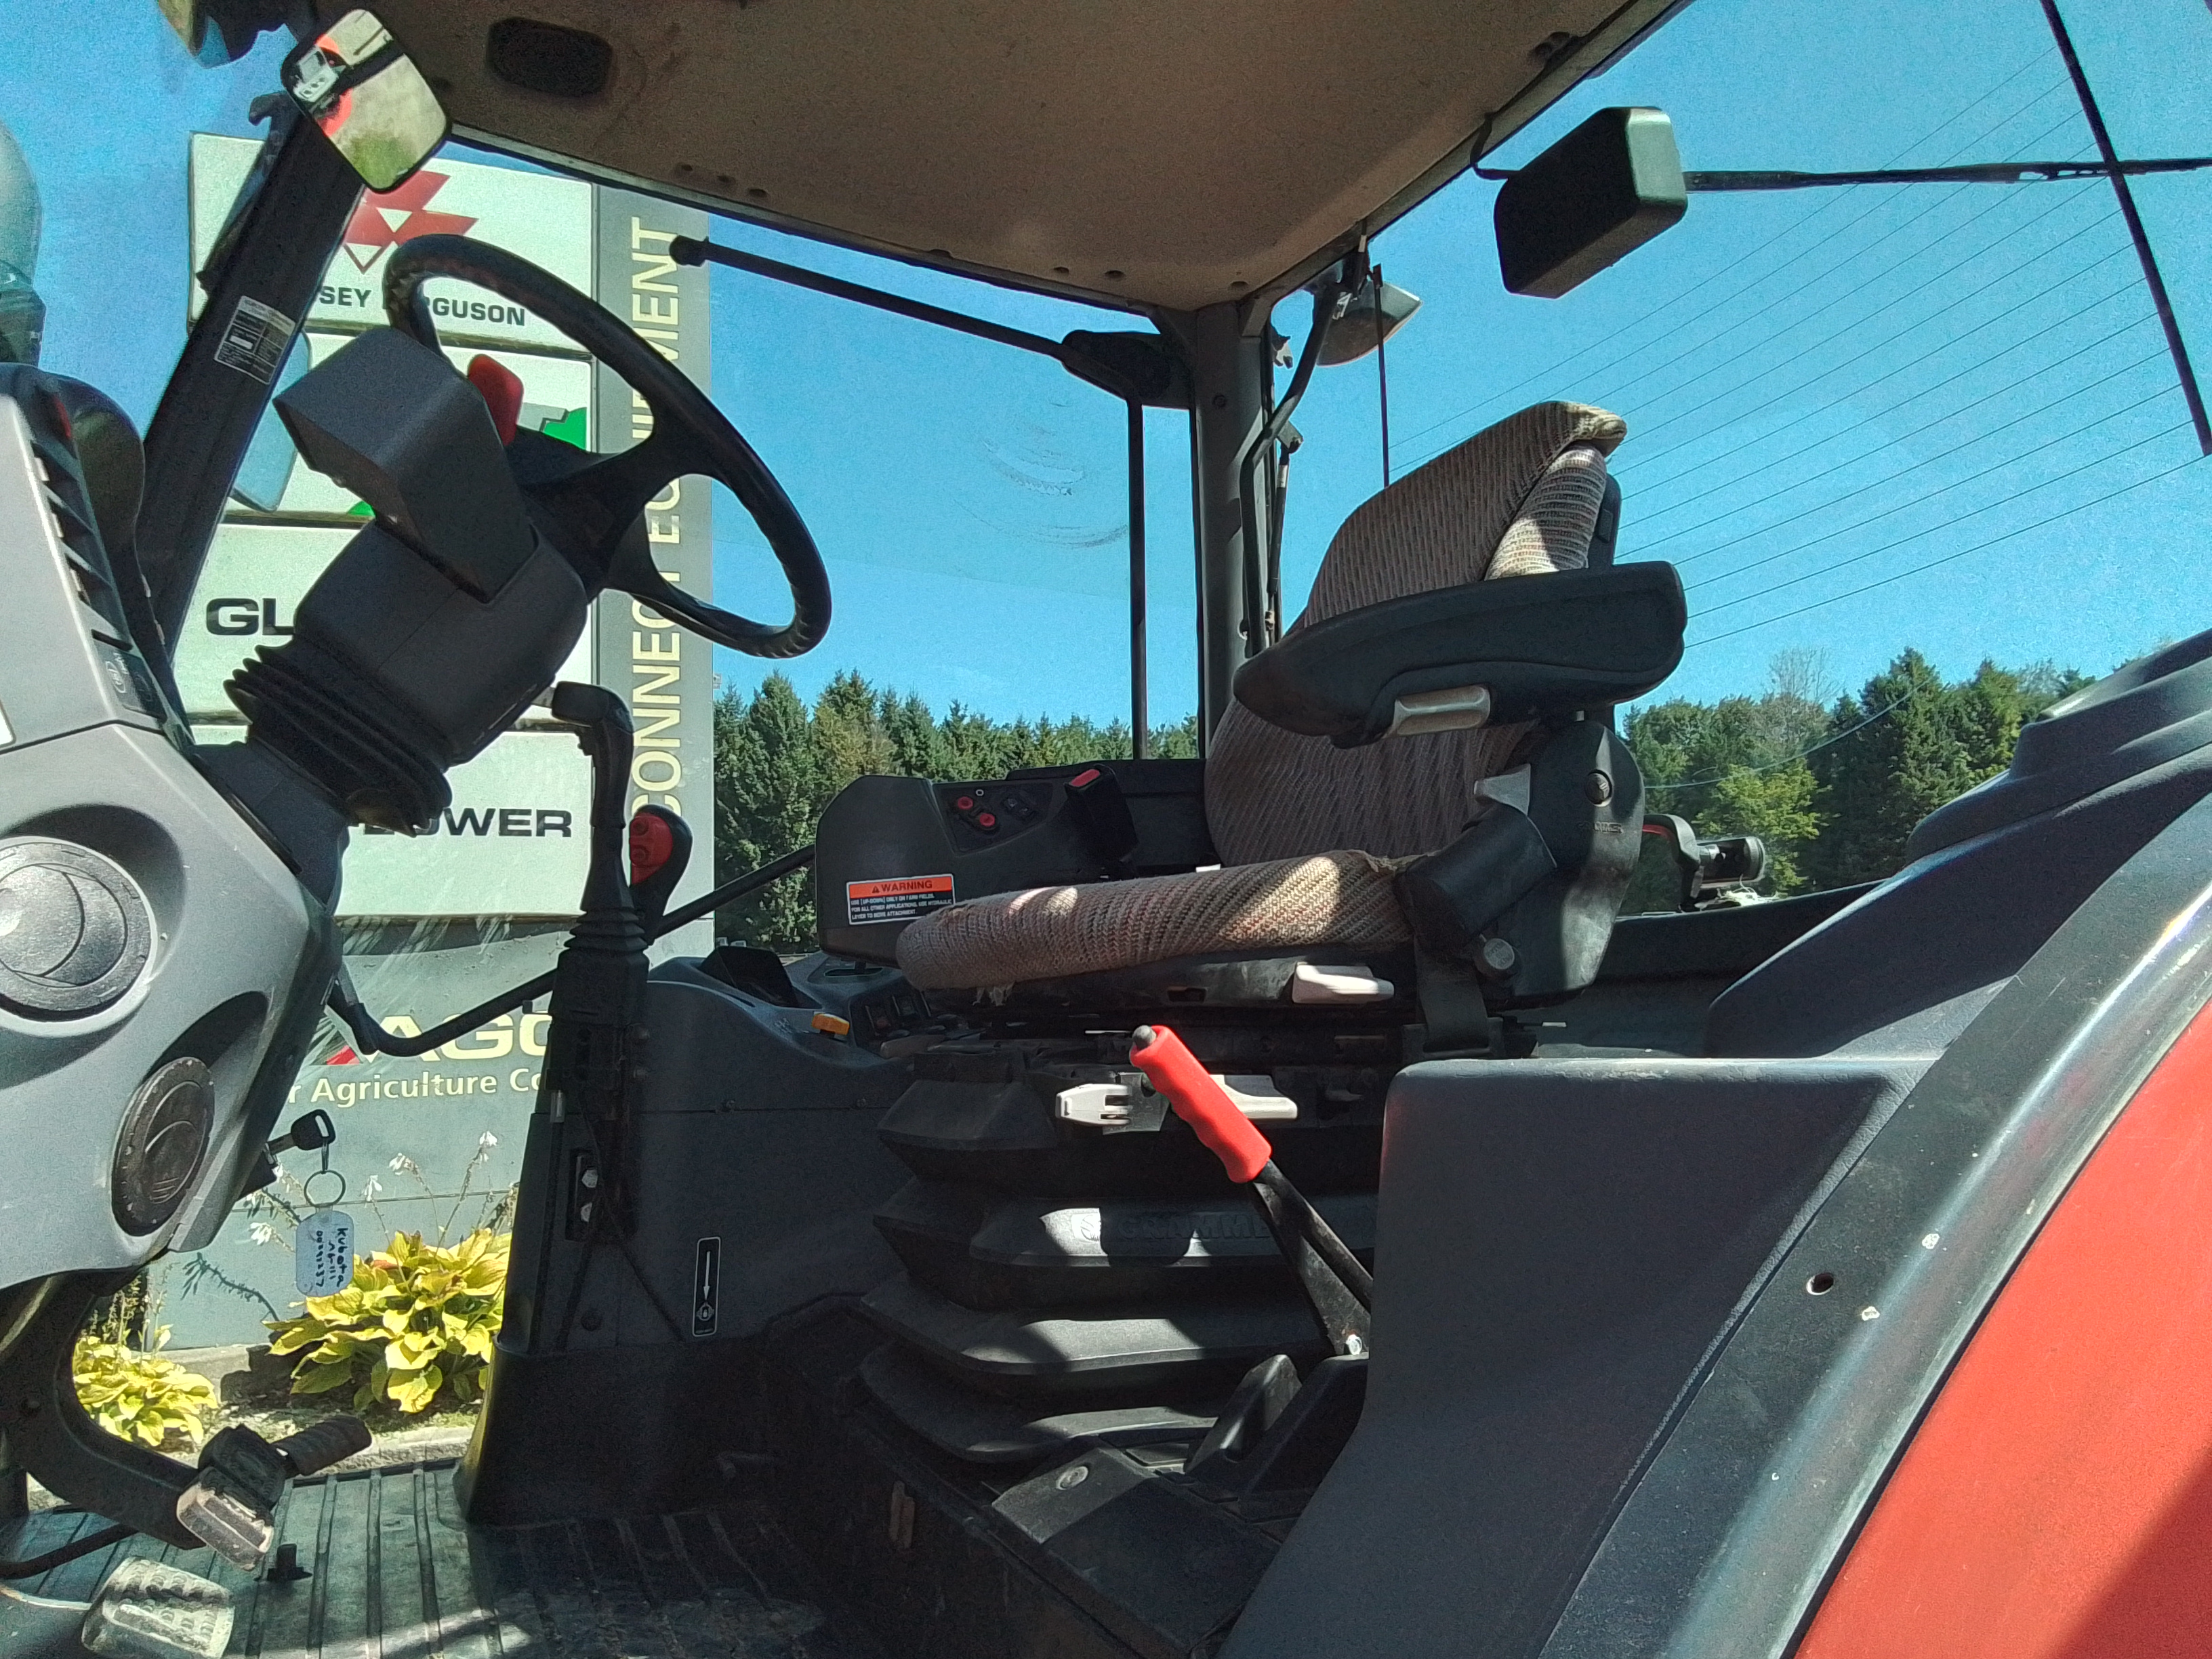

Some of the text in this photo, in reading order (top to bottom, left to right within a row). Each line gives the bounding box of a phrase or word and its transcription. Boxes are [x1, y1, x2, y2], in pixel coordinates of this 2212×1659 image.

[424, 295, 525, 326] GUSON
[881, 880, 933, 893] WARNING
[310, 1071, 497, 1108] Agriculture
